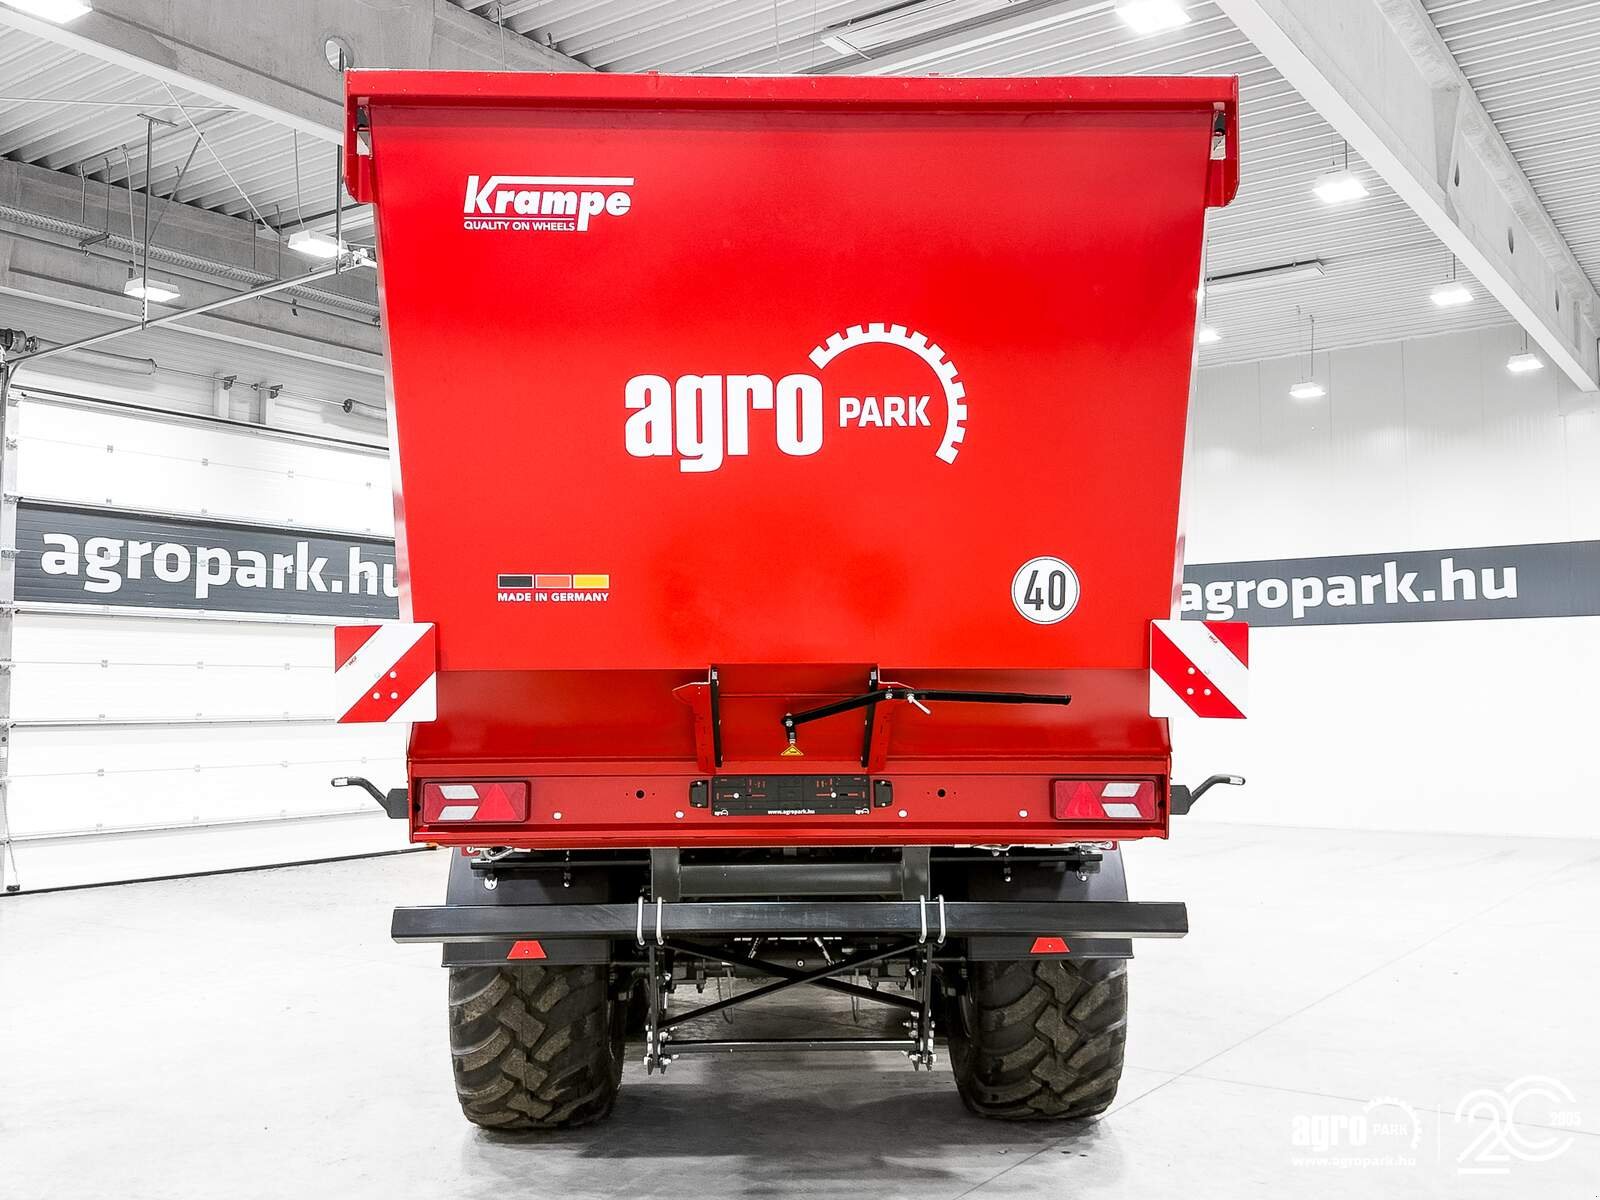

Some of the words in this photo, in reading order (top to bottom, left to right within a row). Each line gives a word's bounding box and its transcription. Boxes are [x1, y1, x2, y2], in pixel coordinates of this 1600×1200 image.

[463, 175, 635, 232] Krampe
[463, 221, 510, 231] QUALITY
[512, 221, 530, 231] ON
[532, 221, 575, 231] WHEELS
[624, 374, 823, 473] agro
[839, 395, 931, 427] PARK
[497, 592, 532, 602] MADE
[535, 592, 548, 602] IN
[551, 592, 609, 602] GERMANY
[1023, 569, 1066, 611] 40
[1181, 557, 1518, 621] agropark.hu
